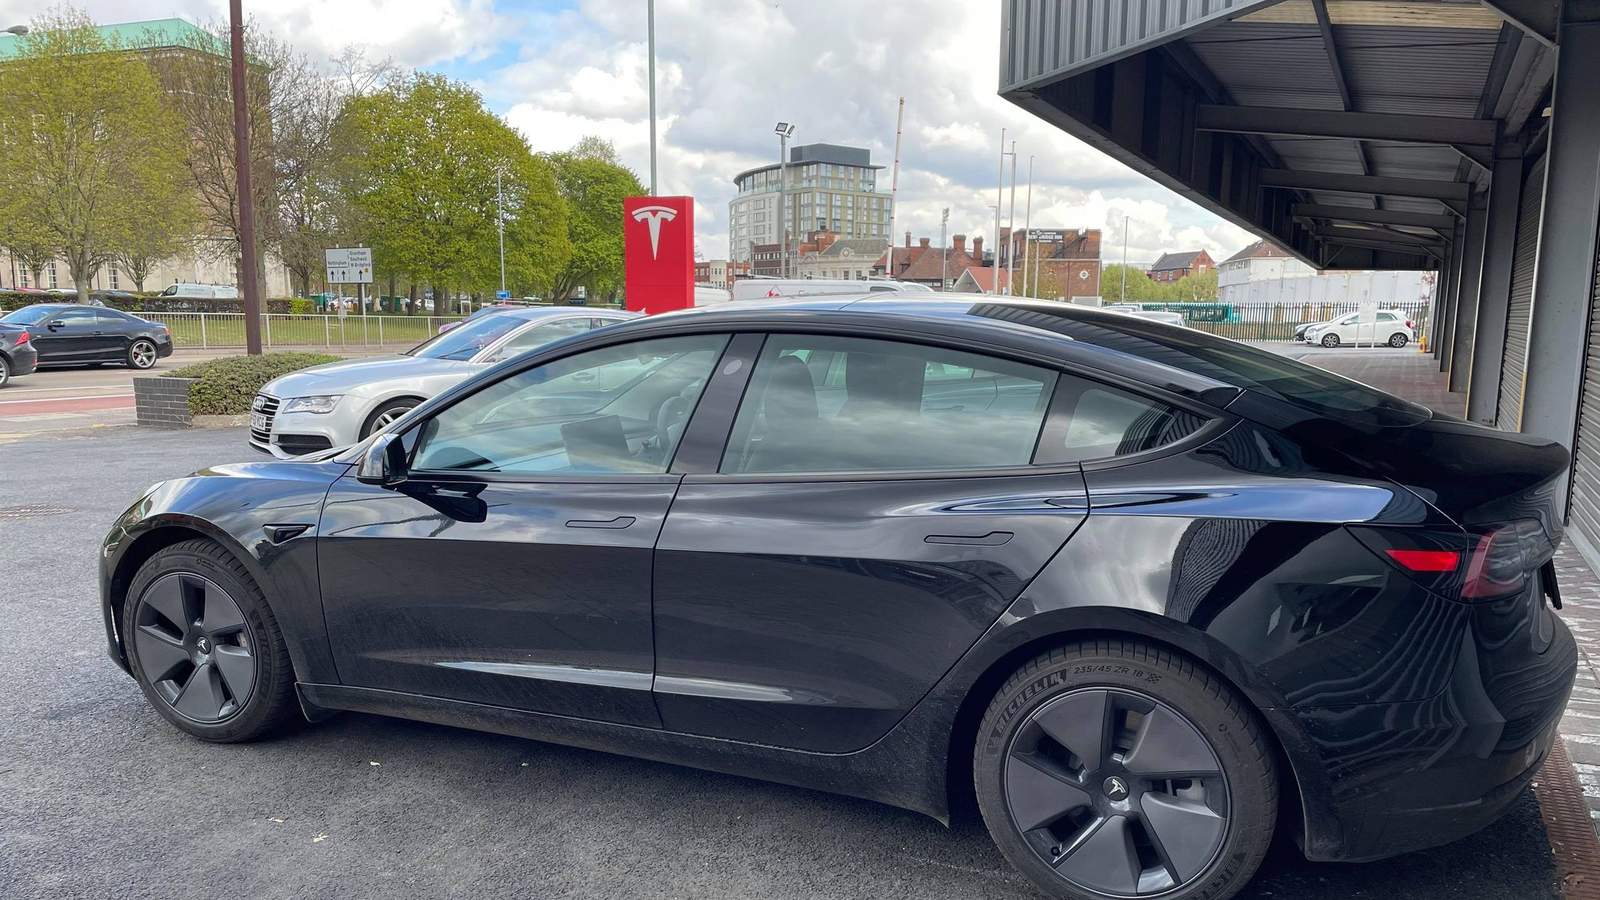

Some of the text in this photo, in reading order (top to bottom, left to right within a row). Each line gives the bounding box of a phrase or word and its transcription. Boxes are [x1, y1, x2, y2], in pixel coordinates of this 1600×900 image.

[1074, 665, 1111, 674] 235/45
[1113, 666, 1129, 674] ZR
[995, 670, 1065, 734] MICHELIN
